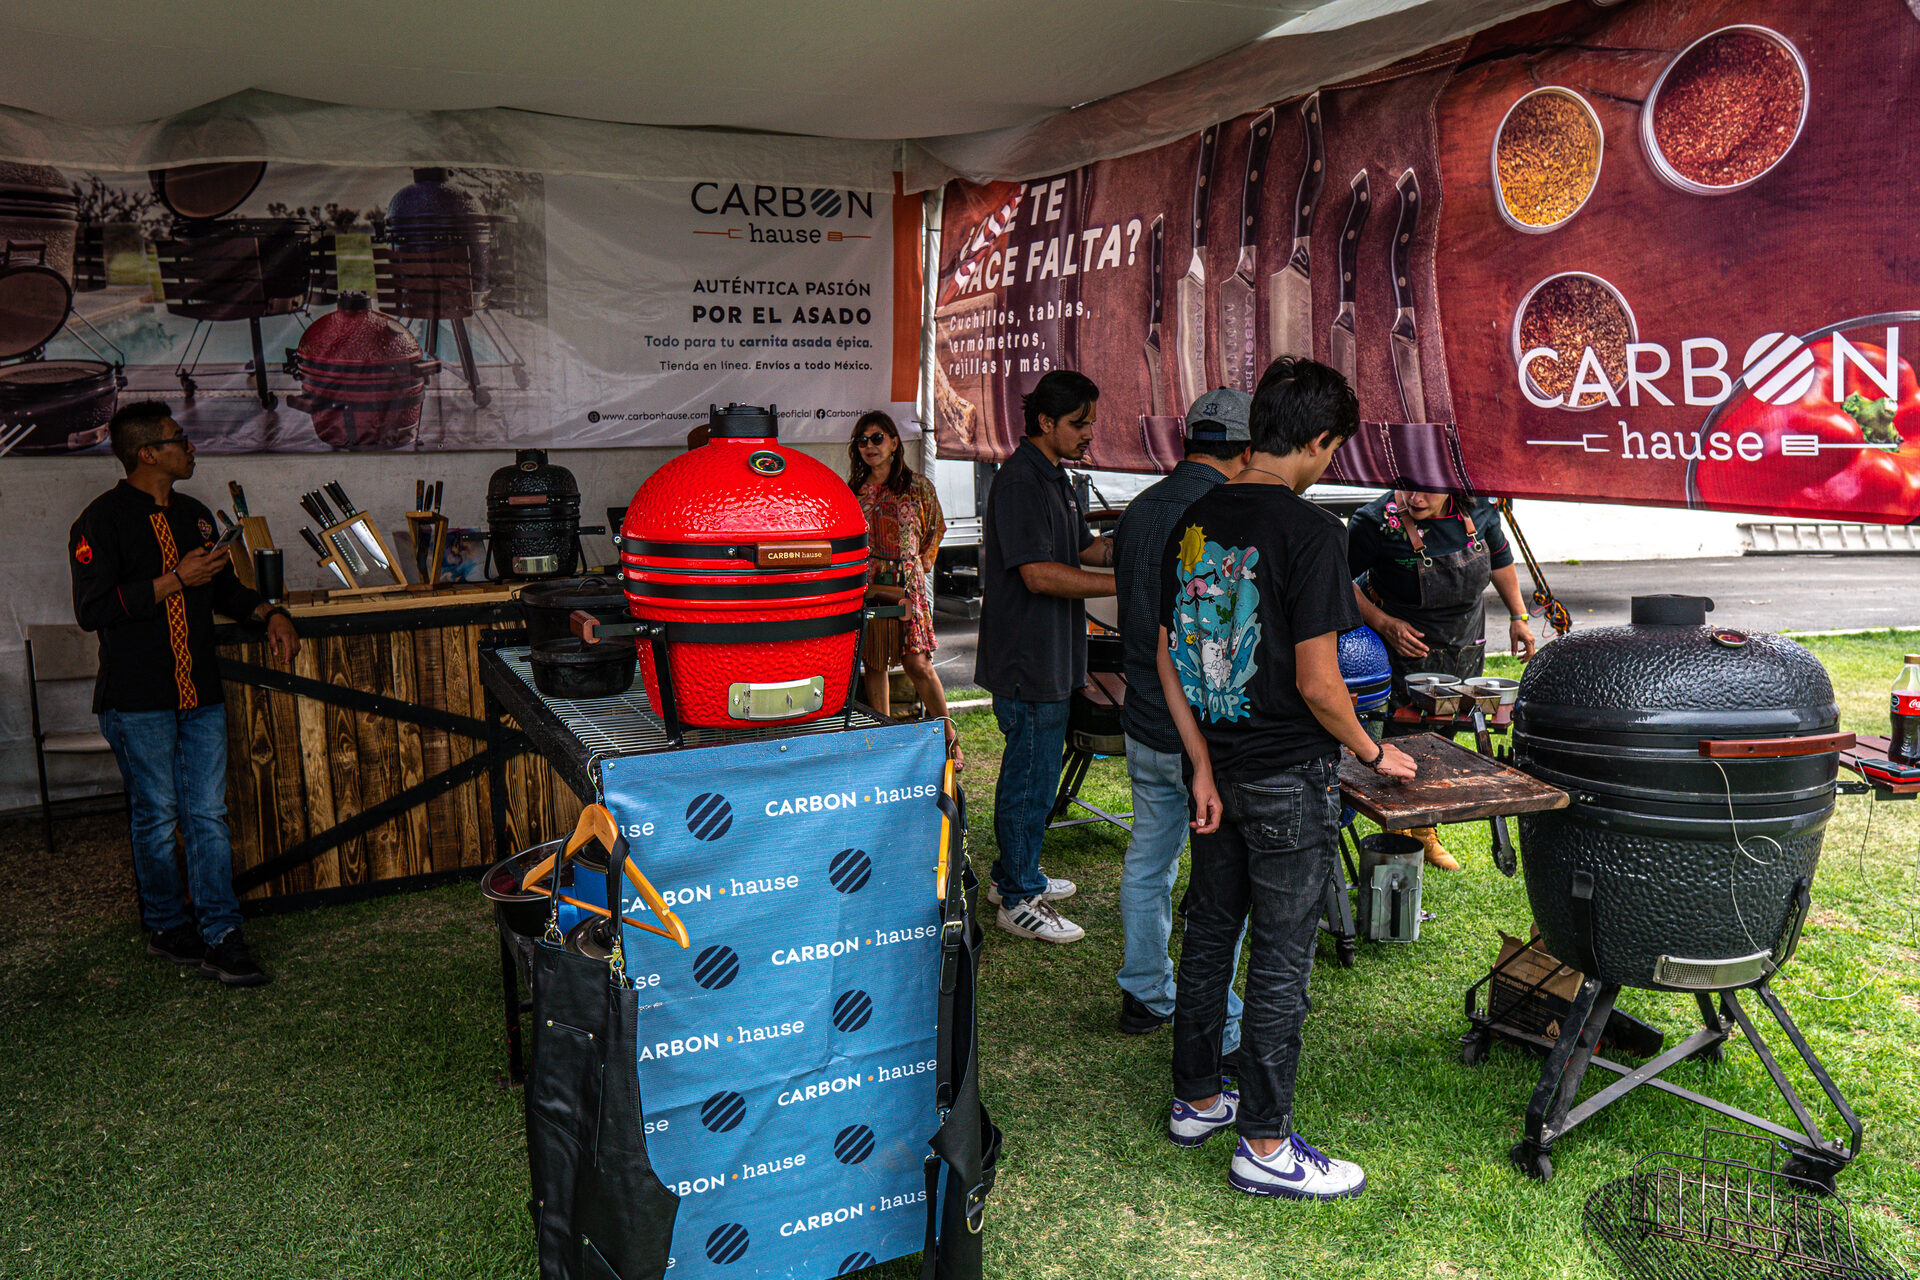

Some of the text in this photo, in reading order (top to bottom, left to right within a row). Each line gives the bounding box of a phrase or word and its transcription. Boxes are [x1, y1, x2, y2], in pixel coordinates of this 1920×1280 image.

[1030, 178, 1066, 226] TE
[748, 223, 821, 243] hause
[956, 246, 1019, 297] ACE
[1026, 219, 1142, 283] FALTA?
[693, 276, 871, 296] AUTÉNTICA PASIÓN
[693, 305, 871, 325] POR EL ASADO
[949, 300, 1092, 332] Cuchillos, tablas,
[644, 335, 873, 351] Todo para tu carnita asada épica.
[949, 332, 1046, 353] termómetros,
[659, 360, 873, 371] Tienda en línea. Envíos a todo México.
[949, 353, 1057, 379] rejillas y más.
[1517, 326, 1899, 409] CARBON
[601, 411, 709, 421] www.carbonhause.com
[1618, 420, 1764, 462] hause
[767, 551, 801, 560] CARBON
[765, 783, 938, 818] CARBON hause
[621, 874, 799, 914] CABON hause
[771, 923, 938, 966] CARBON hause
[638, 1019, 806, 1062] ARBON hause
[777, 1058, 938, 1107] CARBON hause
[742, 1152, 806, 1180] hause
[779, 1190, 927, 1237] CARBON haus
